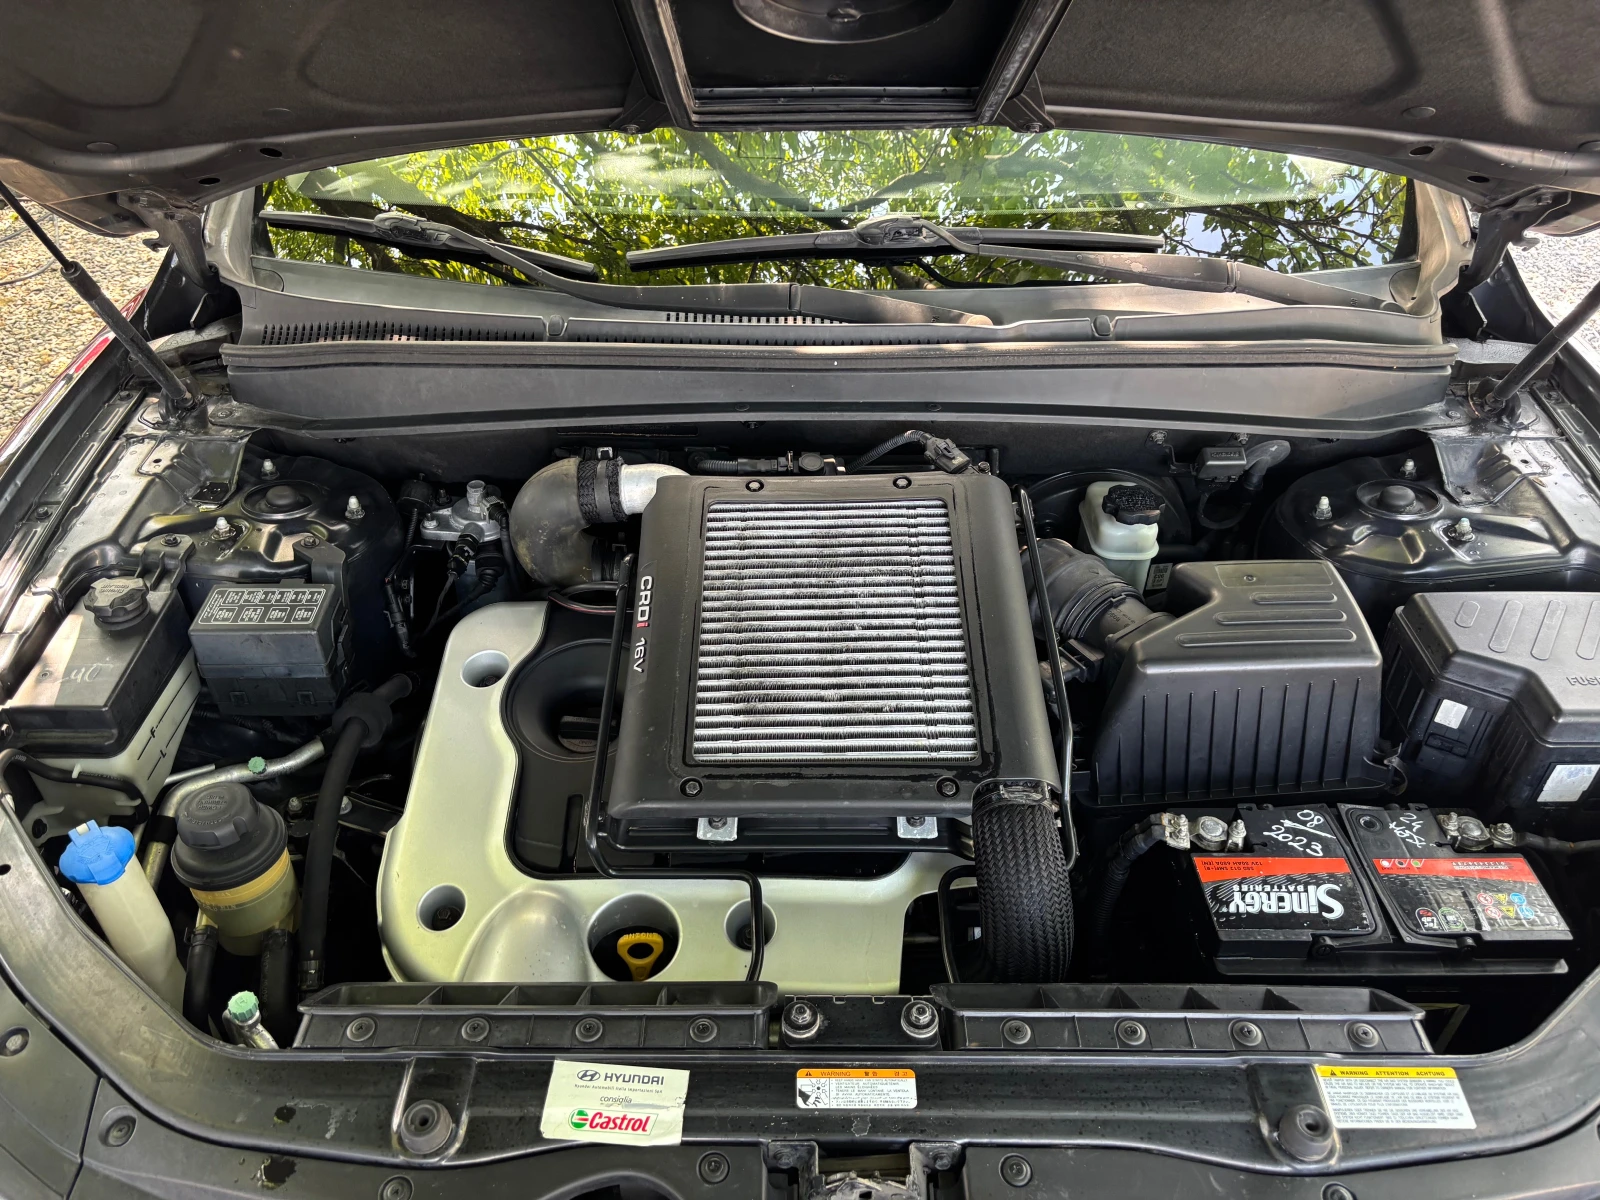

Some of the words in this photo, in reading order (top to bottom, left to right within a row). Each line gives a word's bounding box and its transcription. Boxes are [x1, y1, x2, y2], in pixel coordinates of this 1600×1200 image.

[633, 637, 646, 673] 16V
[1262, 824, 1324, 857] 2023
[1232, 884, 1305, 892] BATTERIES
[604, 1072, 665, 1086] HYUNDAI
[600, 1095, 632, 1105] consiglia
[589, 1112, 651, 1132] Castrol
